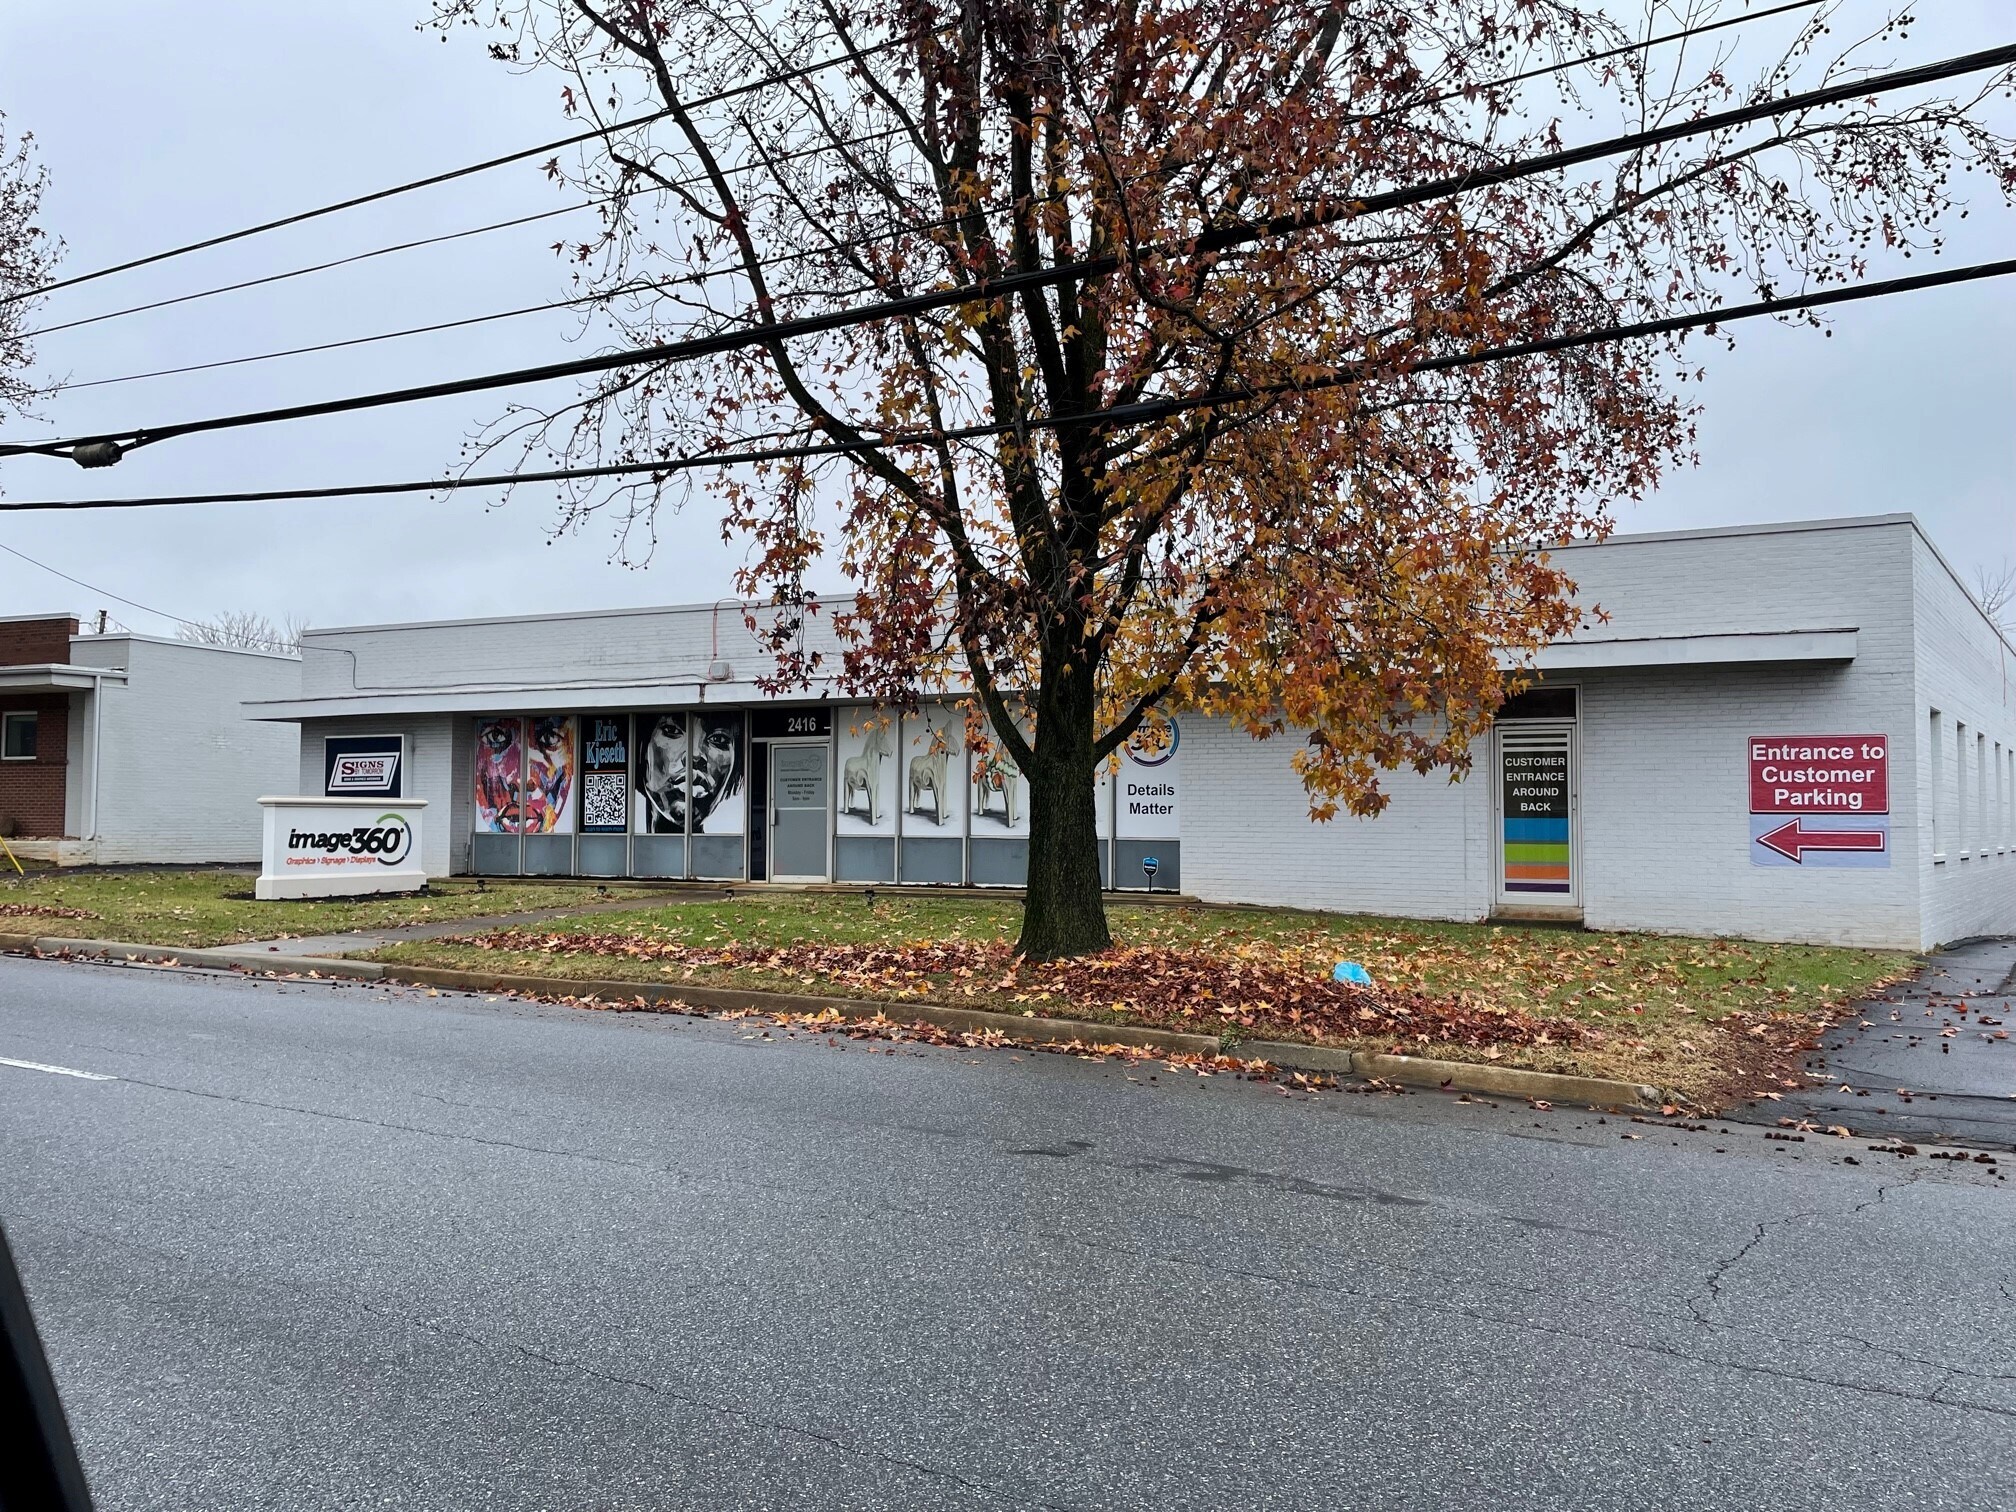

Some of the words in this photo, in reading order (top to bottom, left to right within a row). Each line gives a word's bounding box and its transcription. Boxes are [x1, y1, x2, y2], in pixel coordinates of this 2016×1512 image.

[595, 720, 618, 742] Eric
[788, 717, 816, 732] 2416
[586, 741, 625, 769] Kjeseth
[1752, 744, 1854, 761] Entrance
[1861, 743, 1885, 760] to
[341, 760, 384, 776] SIGNS
[1505, 757, 1565, 767] CUSTOMER
[1506, 772, 1565, 782] ENTRANCE
[1761, 766, 1875, 783] Customer
[1127, 783, 1175, 797] Details
[1512, 787, 1559, 797] AROUND
[1774, 788, 1862, 810] Parking
[1129, 802, 1174, 815] Matter
[1520, 802, 1551, 812] BACK
[286, 857, 316, 866] Graphics
[321, 856, 346, 866] Signage
[350, 855, 376, 865] Displays
